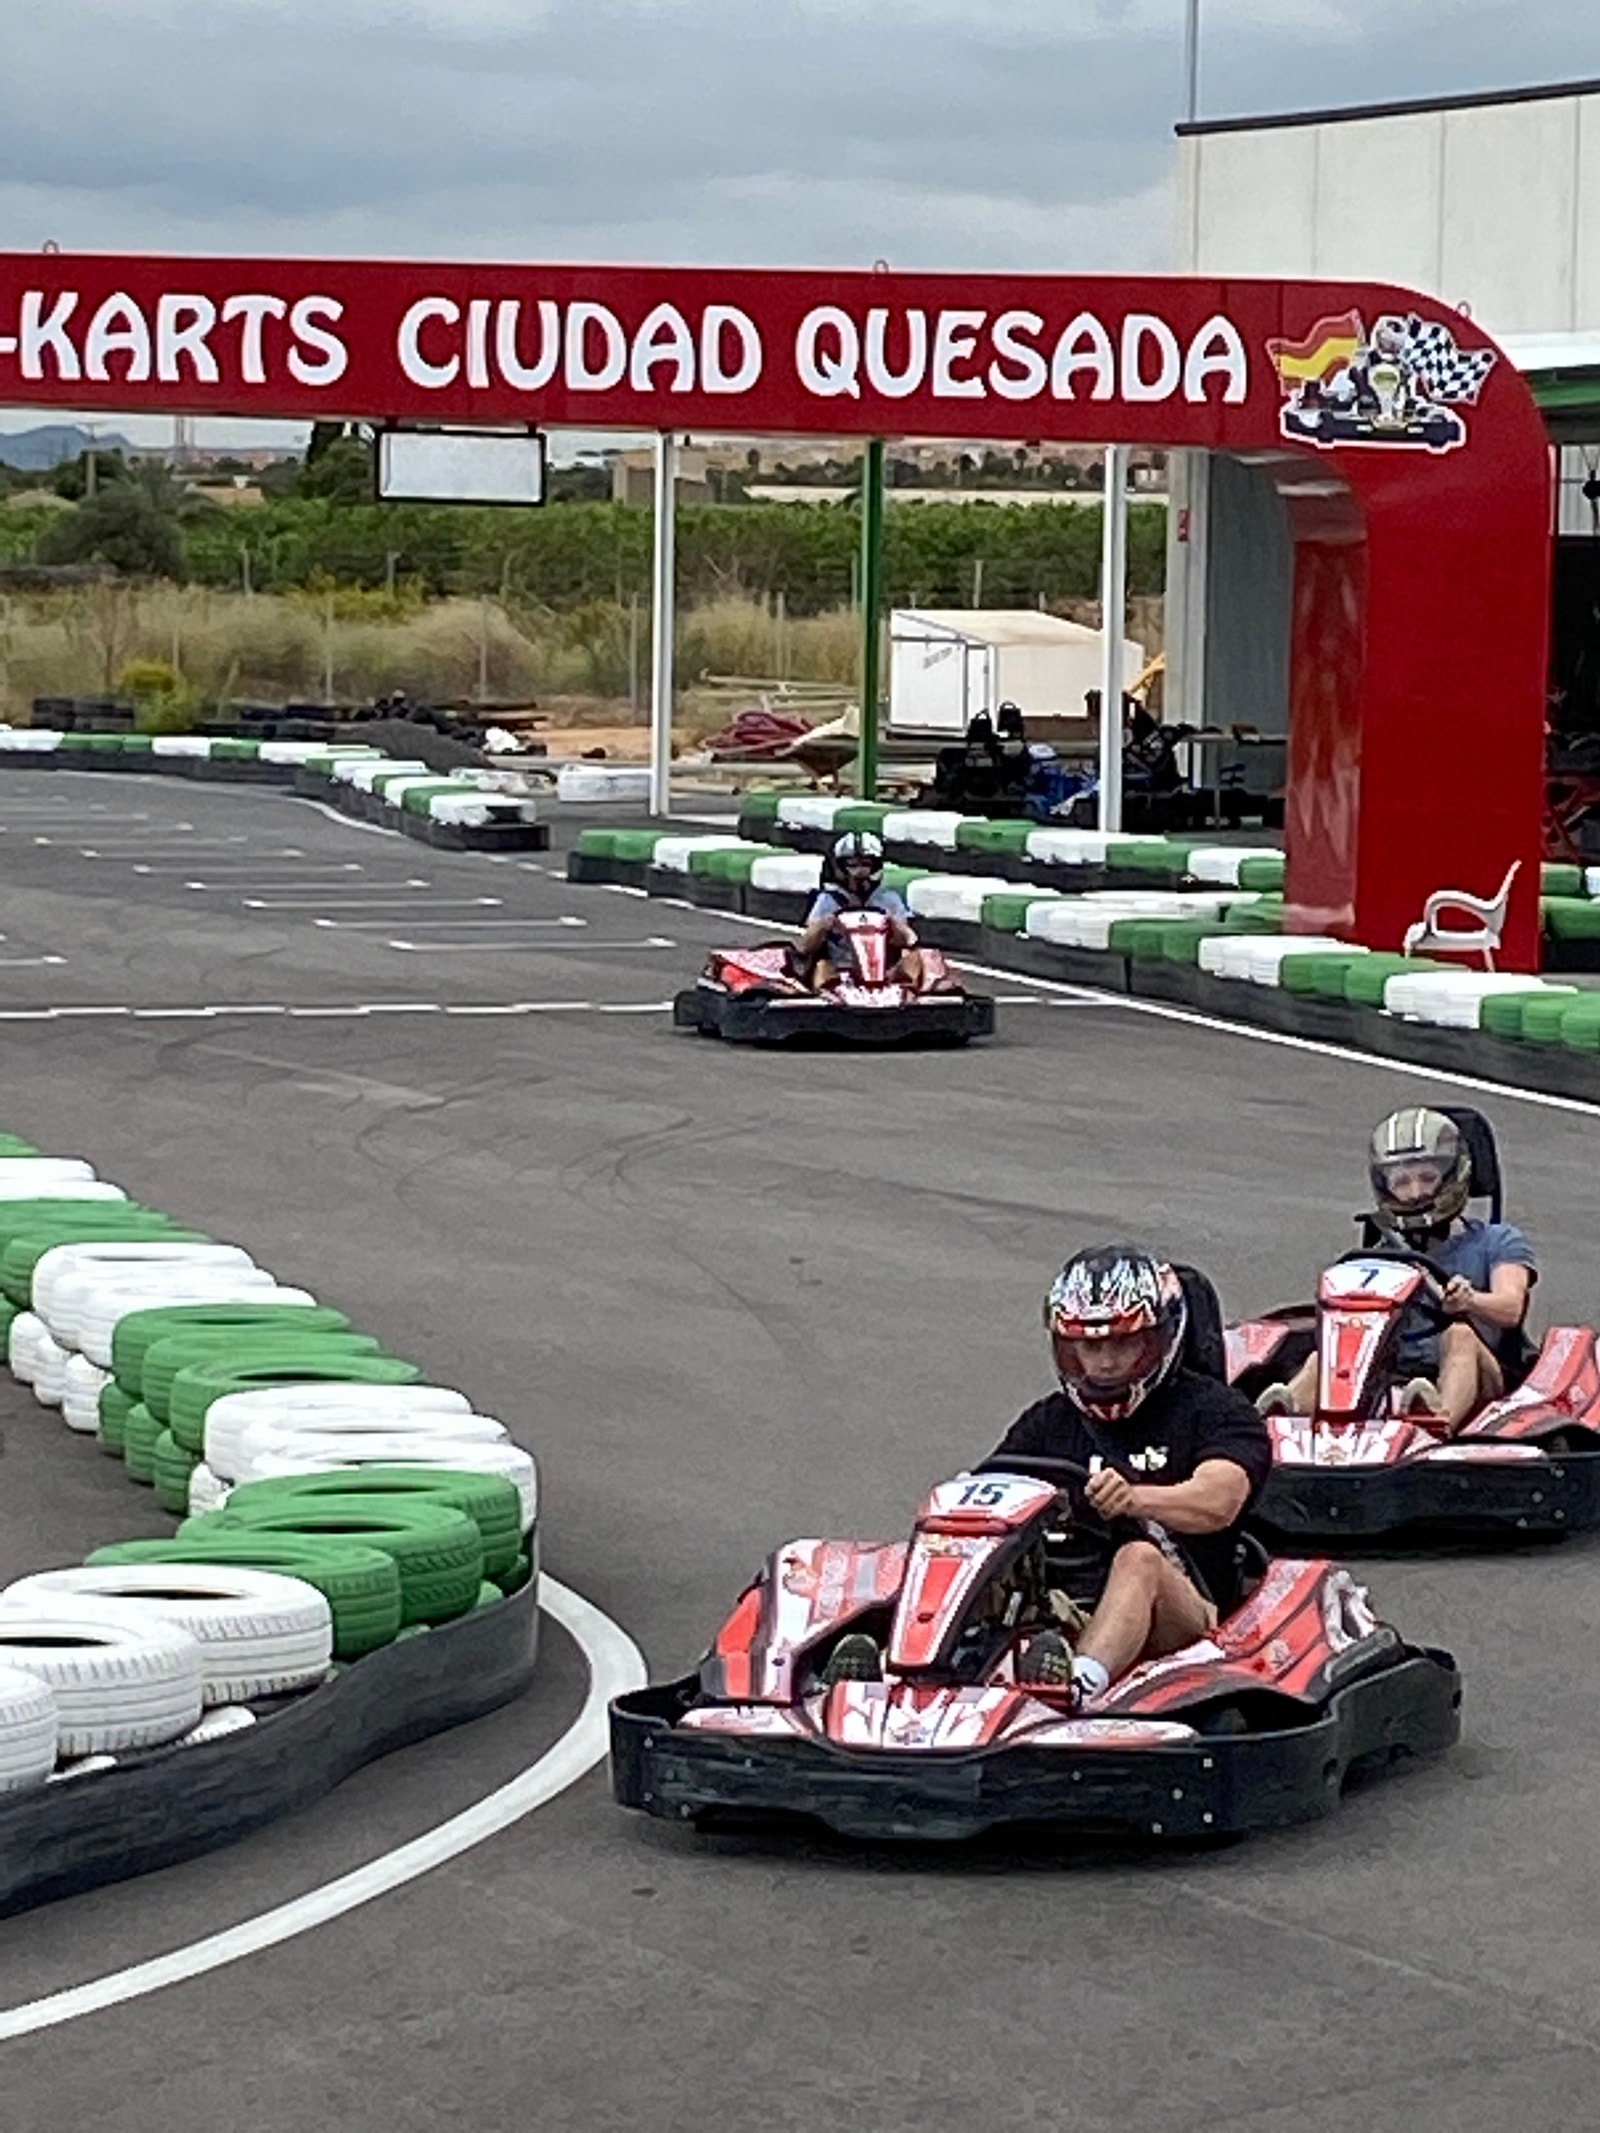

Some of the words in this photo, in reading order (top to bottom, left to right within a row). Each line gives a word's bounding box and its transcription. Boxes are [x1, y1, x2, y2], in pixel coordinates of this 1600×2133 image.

[397, 297, 763, 395] CIUDAD
[795, 304, 1247, 404] QUESADA
[1360, 1268, 1379, 1289] 7
[957, 1483, 1011, 1506] 15
